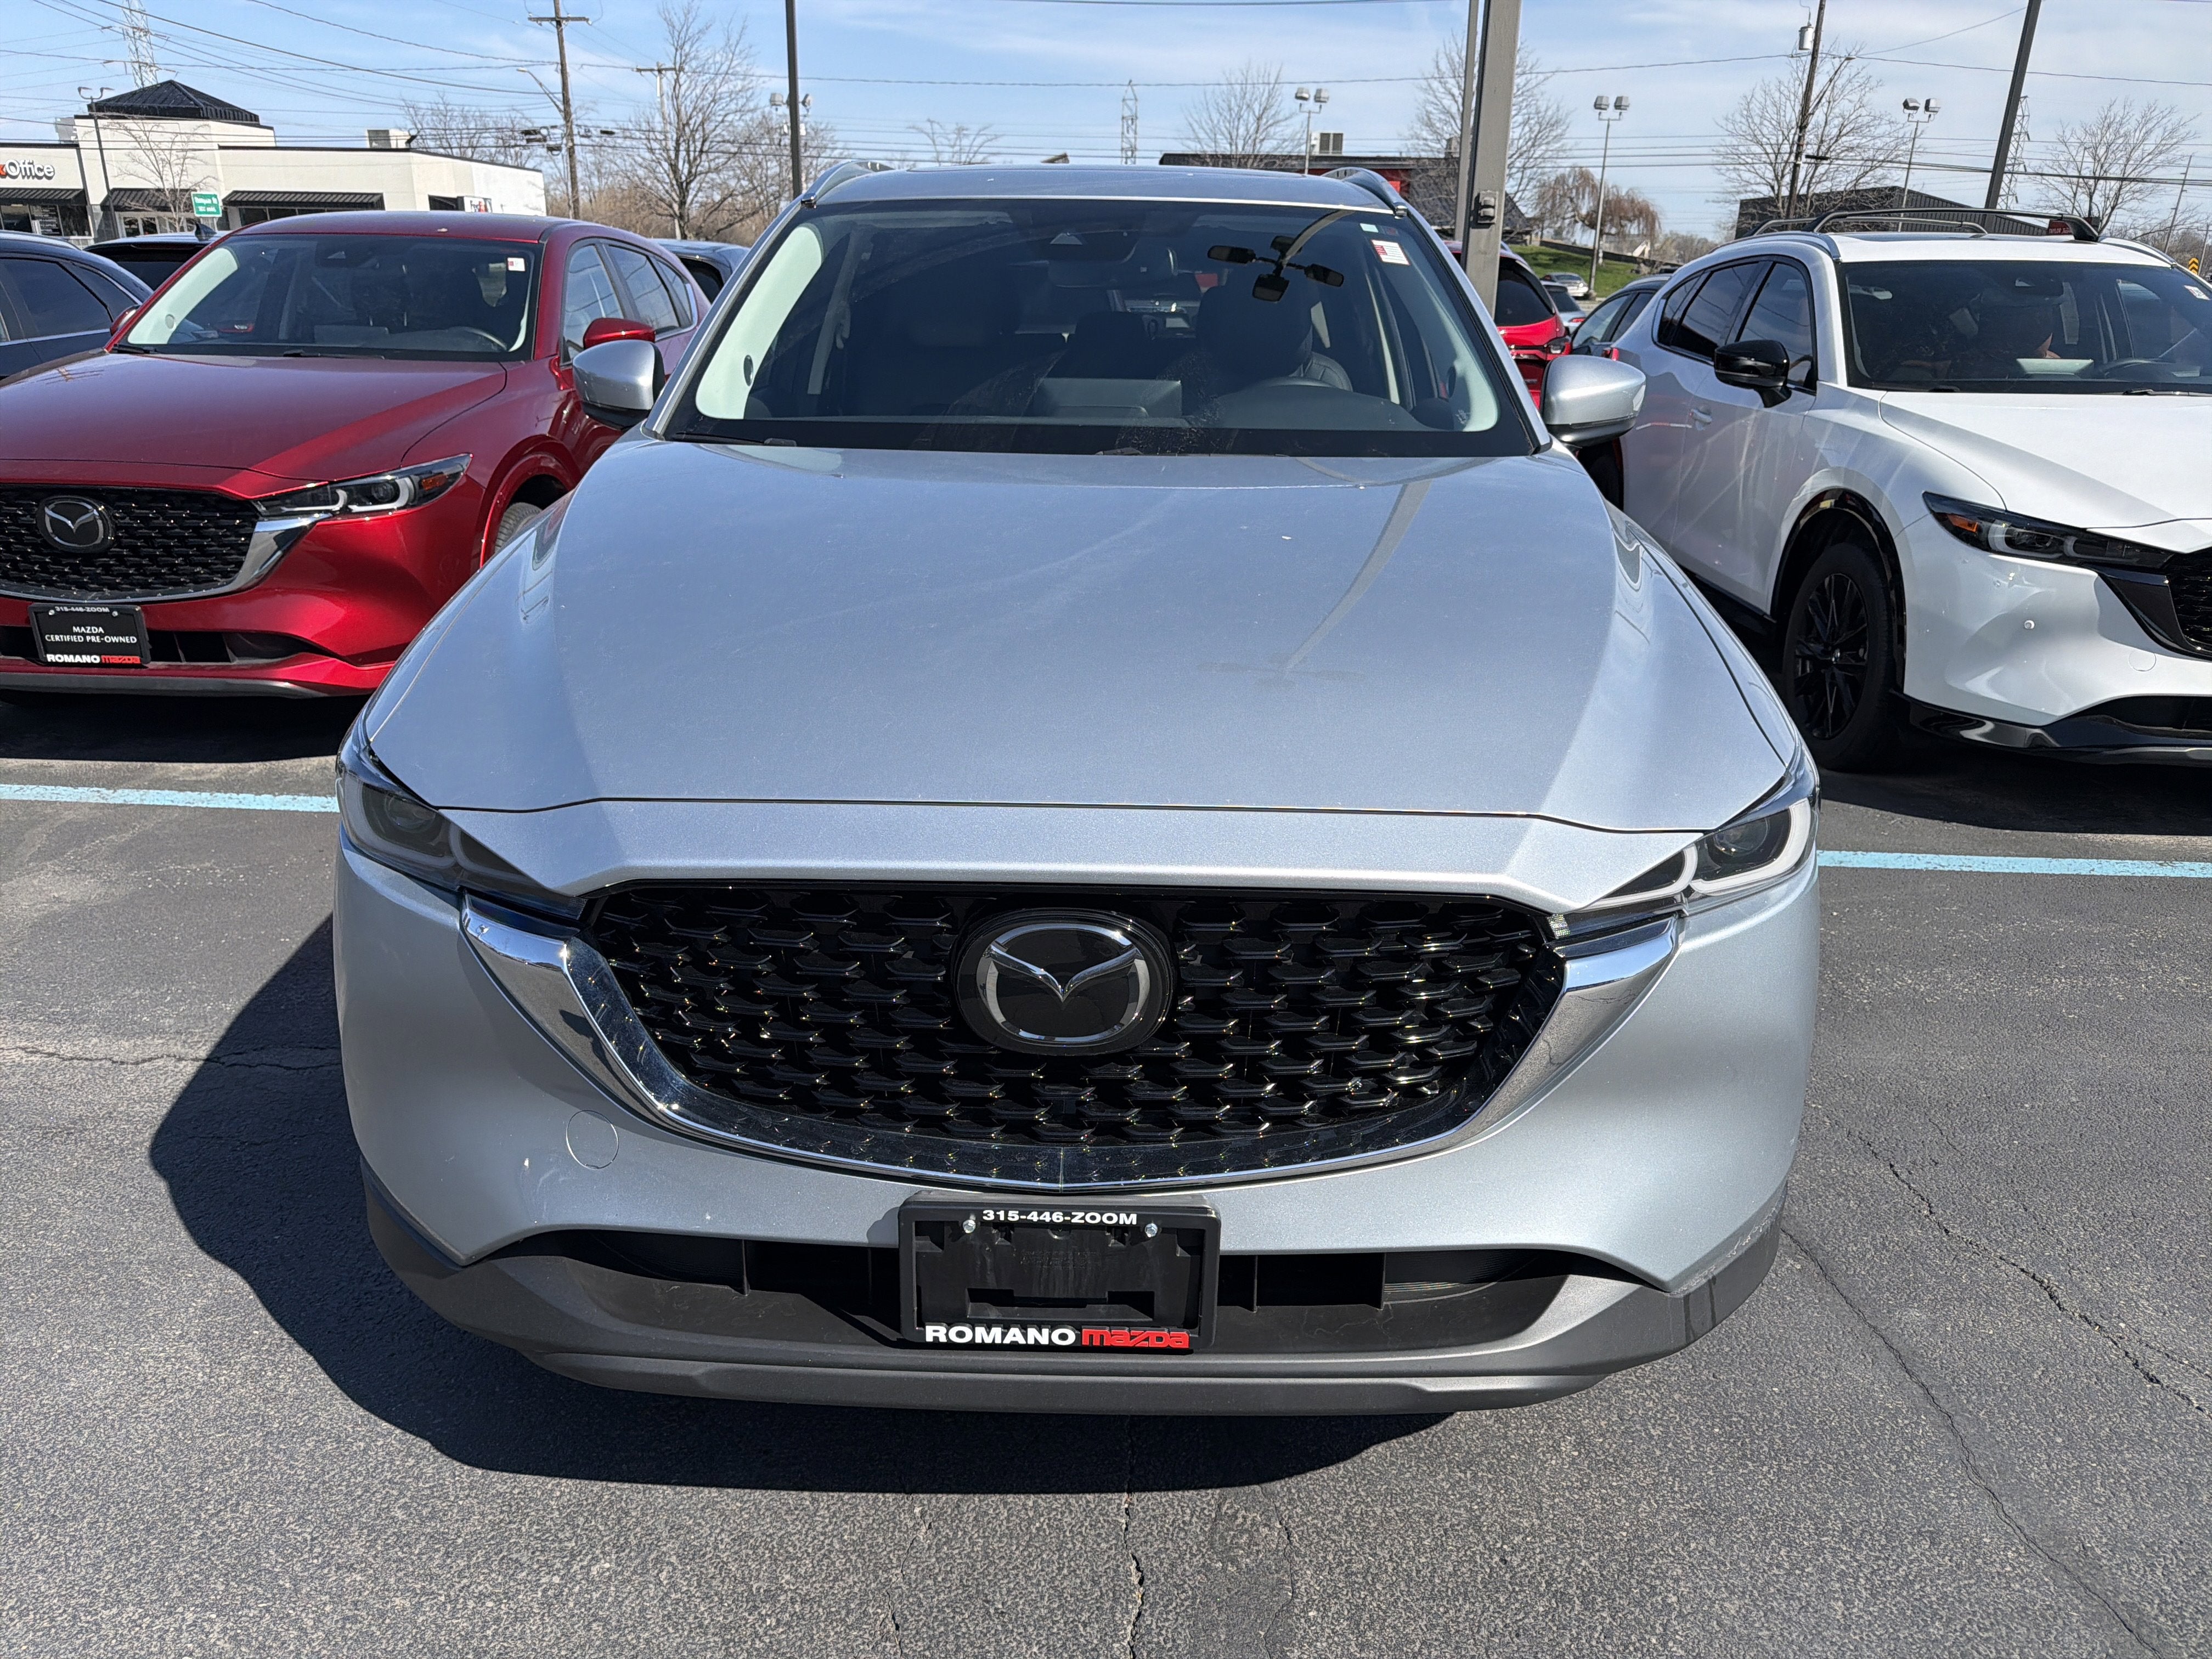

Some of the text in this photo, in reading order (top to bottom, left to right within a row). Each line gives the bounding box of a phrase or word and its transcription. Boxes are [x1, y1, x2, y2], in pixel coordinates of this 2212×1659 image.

[45, 634, 84, 642] CERTIFIED
[46, 653, 100, 663] ROMANO
[983, 1210, 1137, 1224] 315-446-ZOOM
[925, 1325, 1076, 1346] ROMANO
